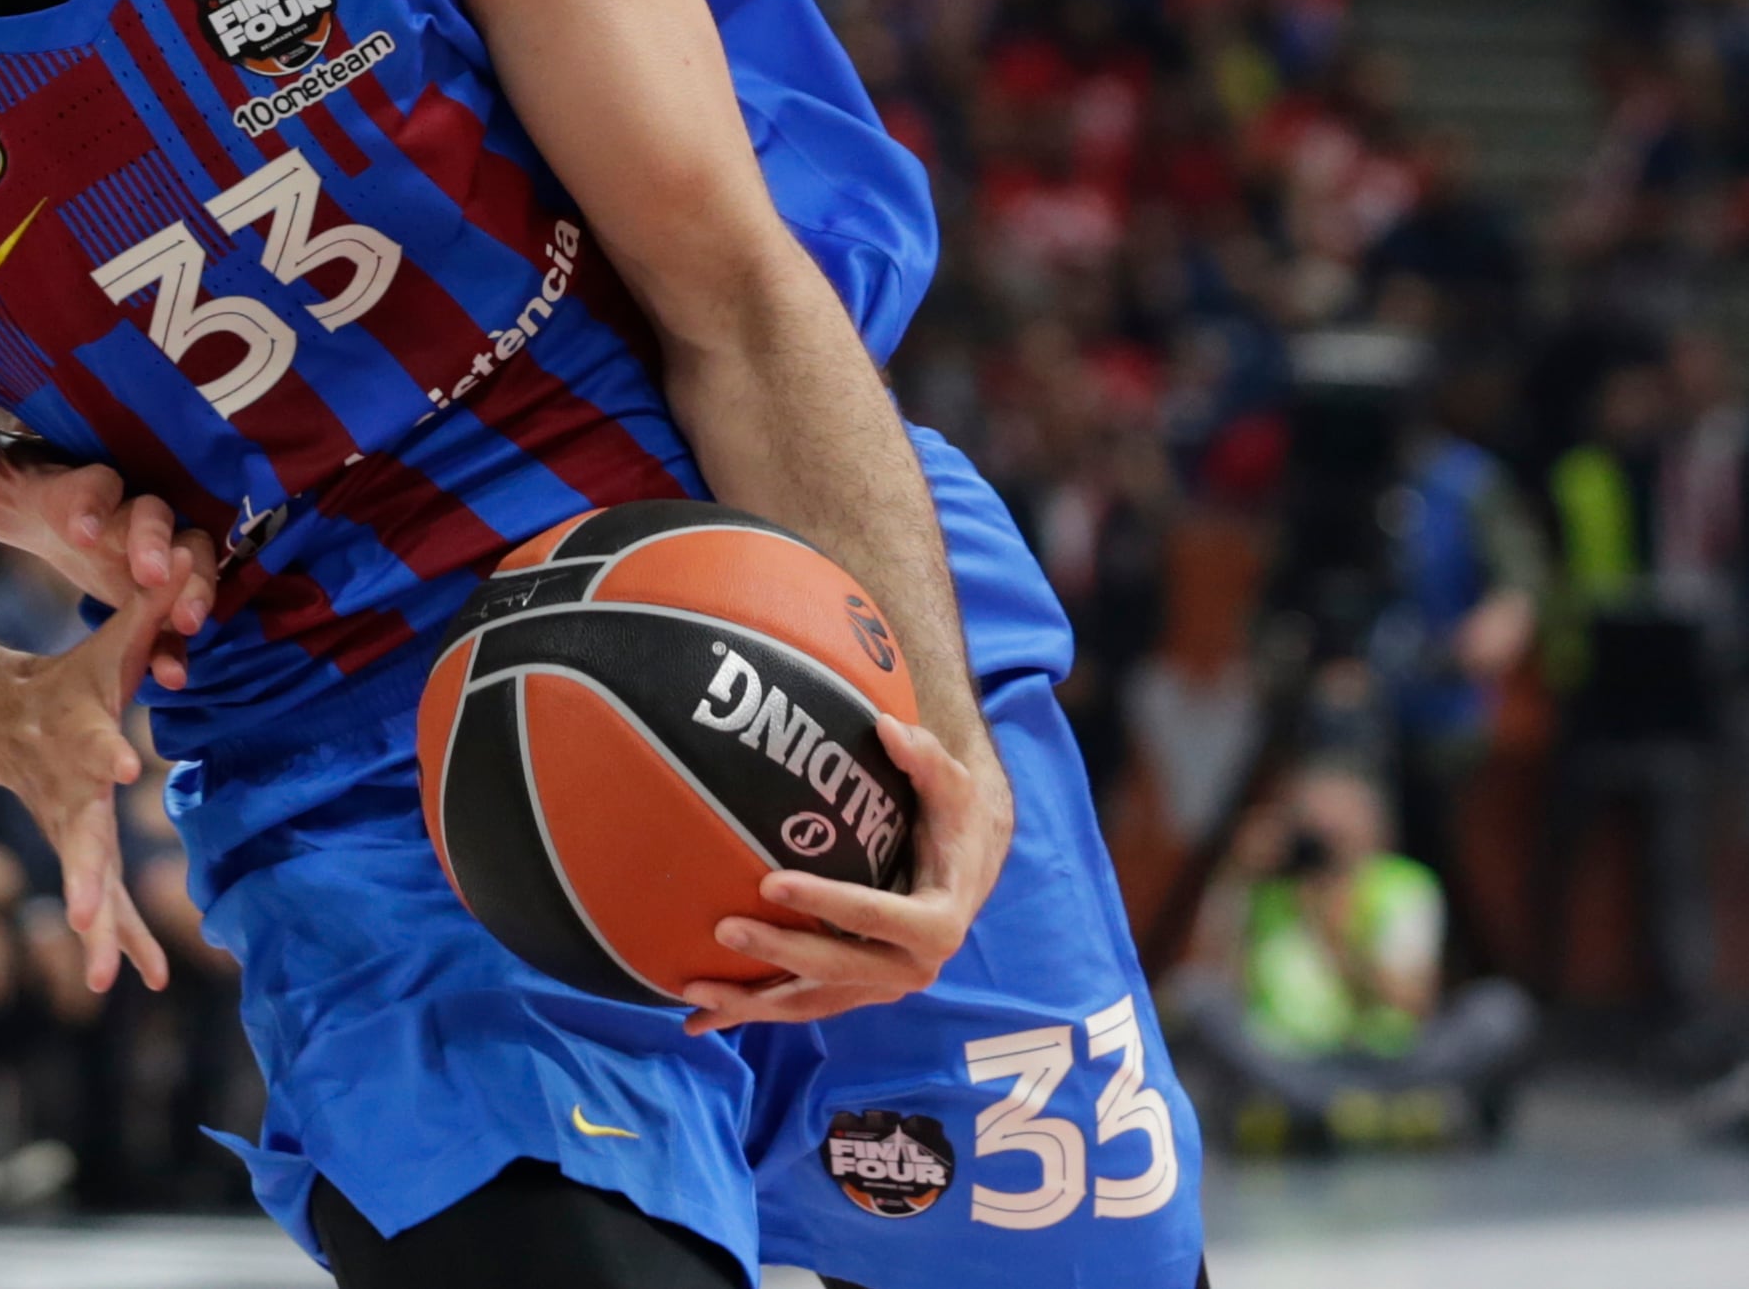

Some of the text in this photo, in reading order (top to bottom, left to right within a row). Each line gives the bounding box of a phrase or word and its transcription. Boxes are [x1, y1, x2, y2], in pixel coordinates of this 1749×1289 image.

[89, 147, 402, 420] 33
[691, 648, 905, 888] PALDING
[831, 1156, 947, 1187] FOUR
[963, 994, 1179, 1230] 33
